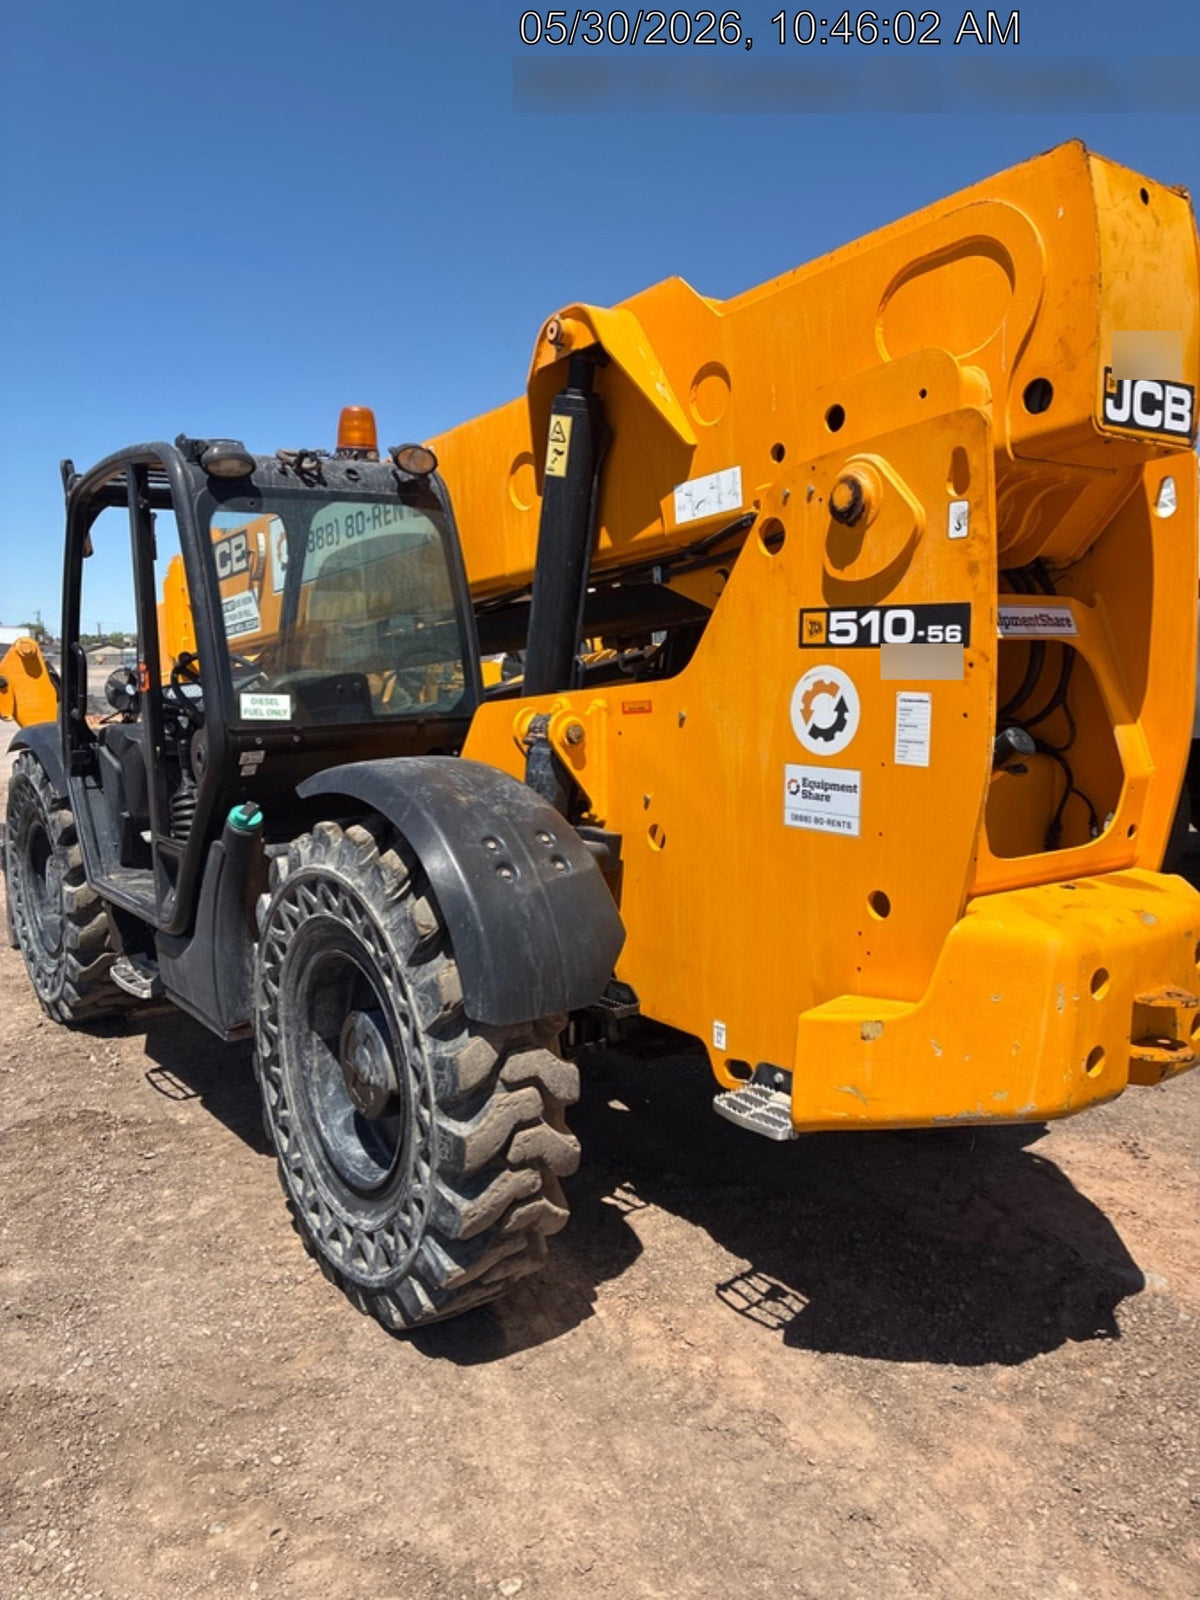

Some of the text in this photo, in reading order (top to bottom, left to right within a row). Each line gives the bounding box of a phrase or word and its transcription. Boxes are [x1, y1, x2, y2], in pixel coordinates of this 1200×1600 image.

[1105, 379, 1192, 433] JCB
[307, 518, 341, 553] 888)
[214, 534, 248, 579] CB
[997, 613, 1073, 629] ipmentShare
[250, 697, 280, 706] DIESEL
[243, 708, 288, 717] FUEL ONLY
[802, 777, 858, 793] Equipment
[802, 789, 831, 802] Share
